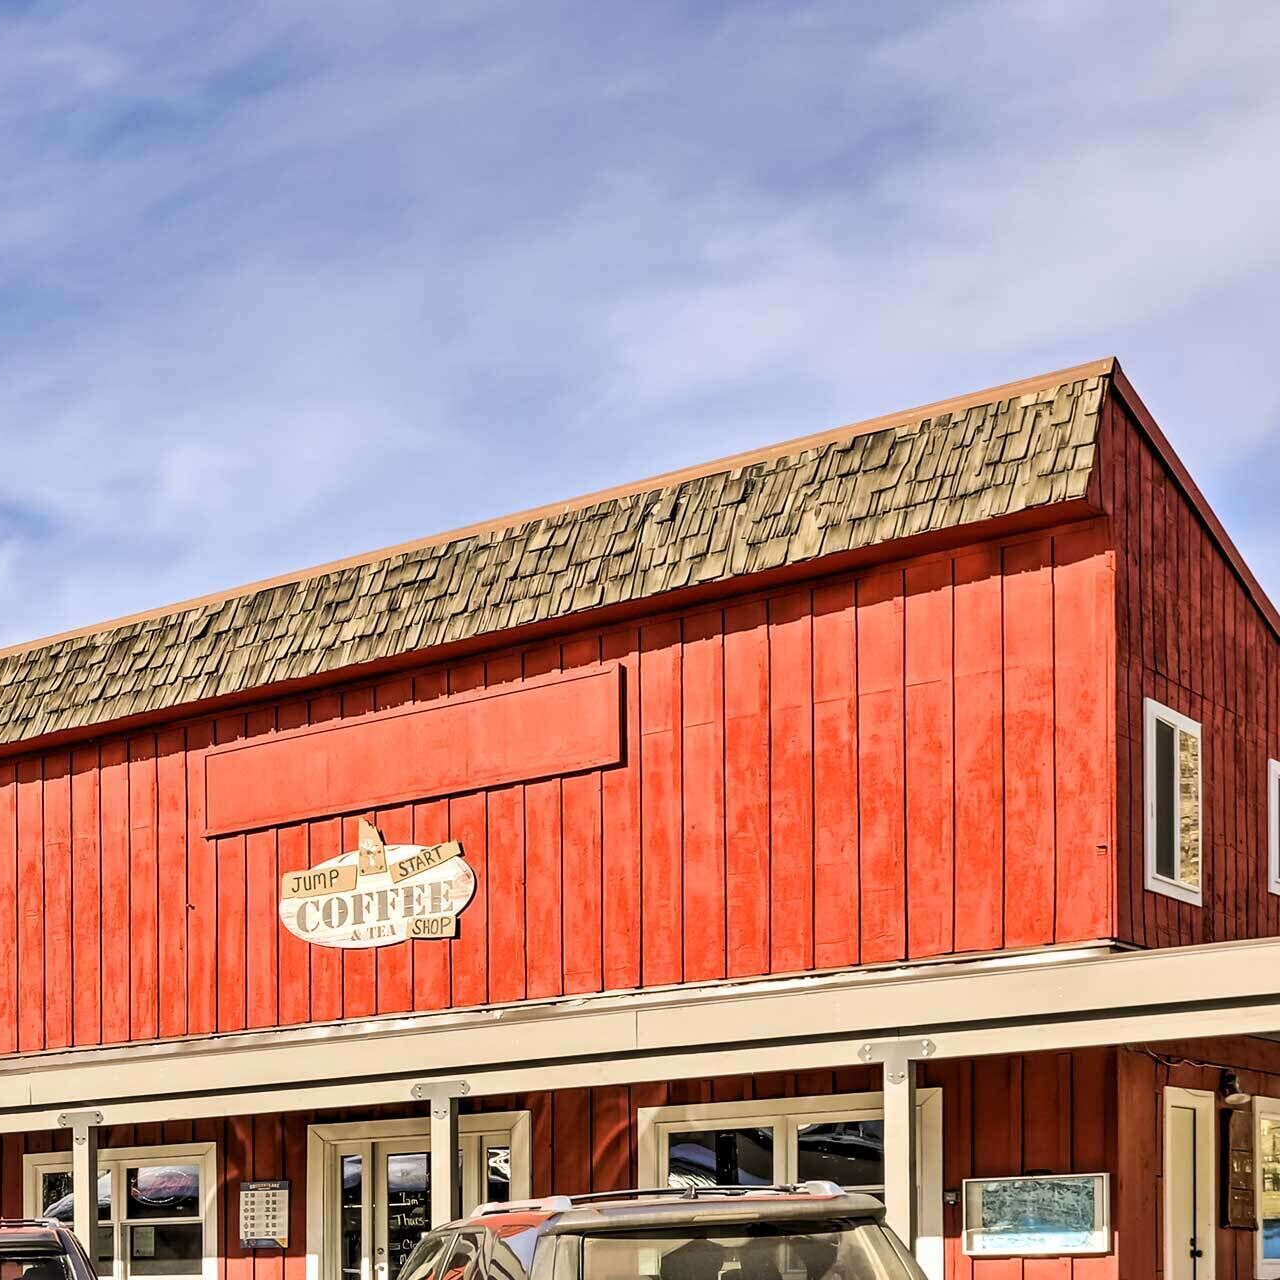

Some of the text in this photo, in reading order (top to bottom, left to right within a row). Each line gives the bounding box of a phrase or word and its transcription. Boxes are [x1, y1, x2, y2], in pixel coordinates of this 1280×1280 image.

[291, 846, 443, 893] JUMP START
[296, 880, 453, 933] COFFEE
[351, 924, 396, 941] & TEA
[412, 917, 452, 935] SHOP
